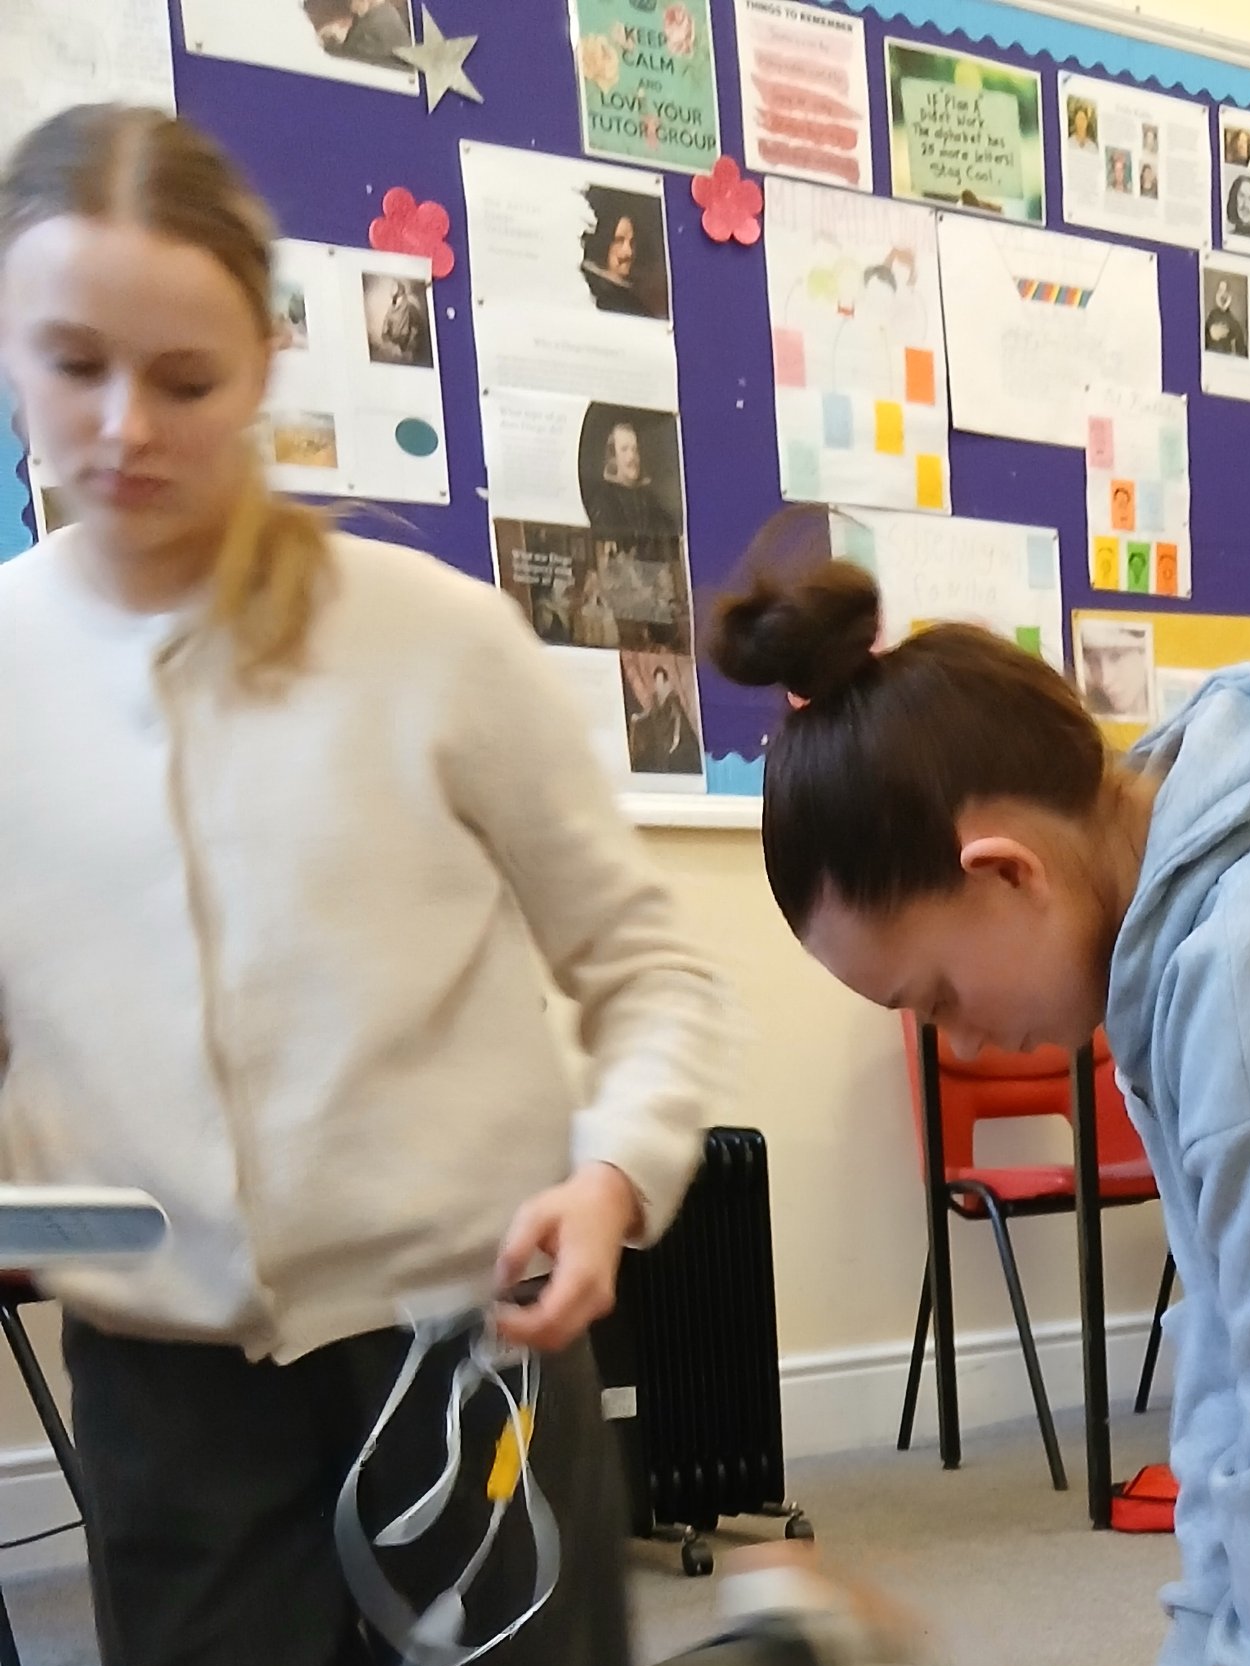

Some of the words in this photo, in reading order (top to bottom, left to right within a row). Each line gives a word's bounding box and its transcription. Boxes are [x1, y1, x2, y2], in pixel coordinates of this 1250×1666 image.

[746, 1, 782, 16] THINGS
[785, 9, 797, 20] TO
[799, 13, 853, 32] REMEMBER
[624, 26, 668, 47] KEEP
[622, 49, 675, 74] CALM
[638, 79, 663, 93] AND
[600, 91, 645, 113] LOVE
[653, 102, 702, 126] YOUR
[589, 112, 649, 138] TUTOR
[655, 126, 716, 151] GROUP
[913, 121, 929, 137] The
[934, 127, 981, 148] alphabet
[987, 134, 1005, 148] has
[940, 149, 968, 161] more
[930, 162, 961, 186] Stay
